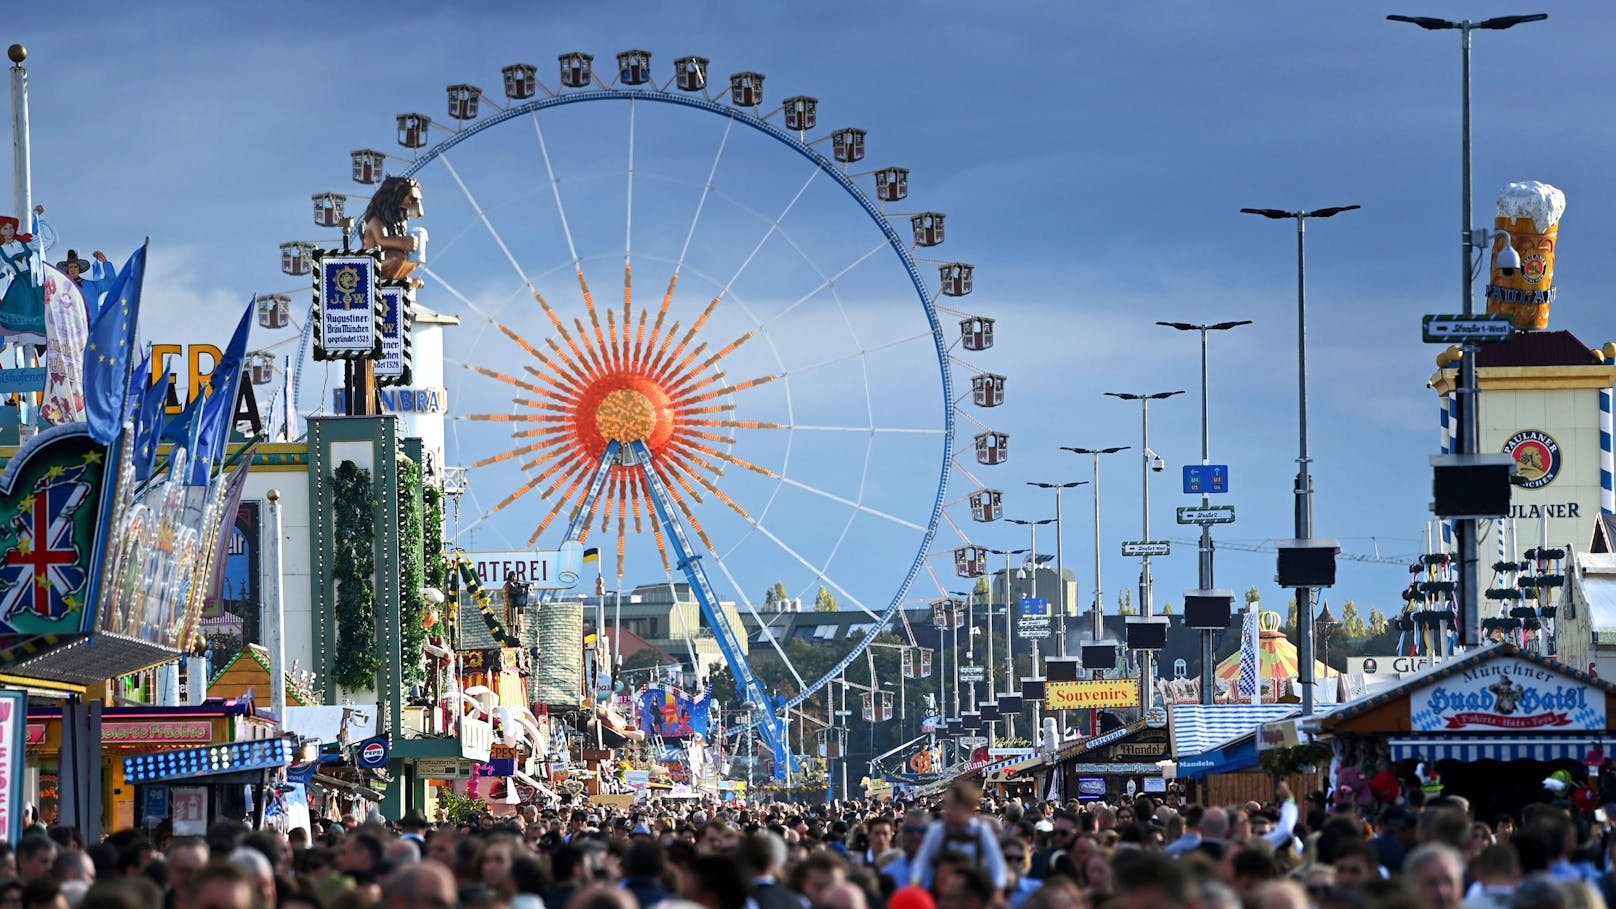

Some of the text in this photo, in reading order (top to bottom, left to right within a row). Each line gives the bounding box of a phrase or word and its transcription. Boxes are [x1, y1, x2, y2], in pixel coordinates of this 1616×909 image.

[1504, 432, 1558, 454] PAULANER
[1463, 662, 1555, 684] Münchner
[1056, 687, 1128, 702] Souvenirs
[1179, 760, 1215, 768] Mandeln
